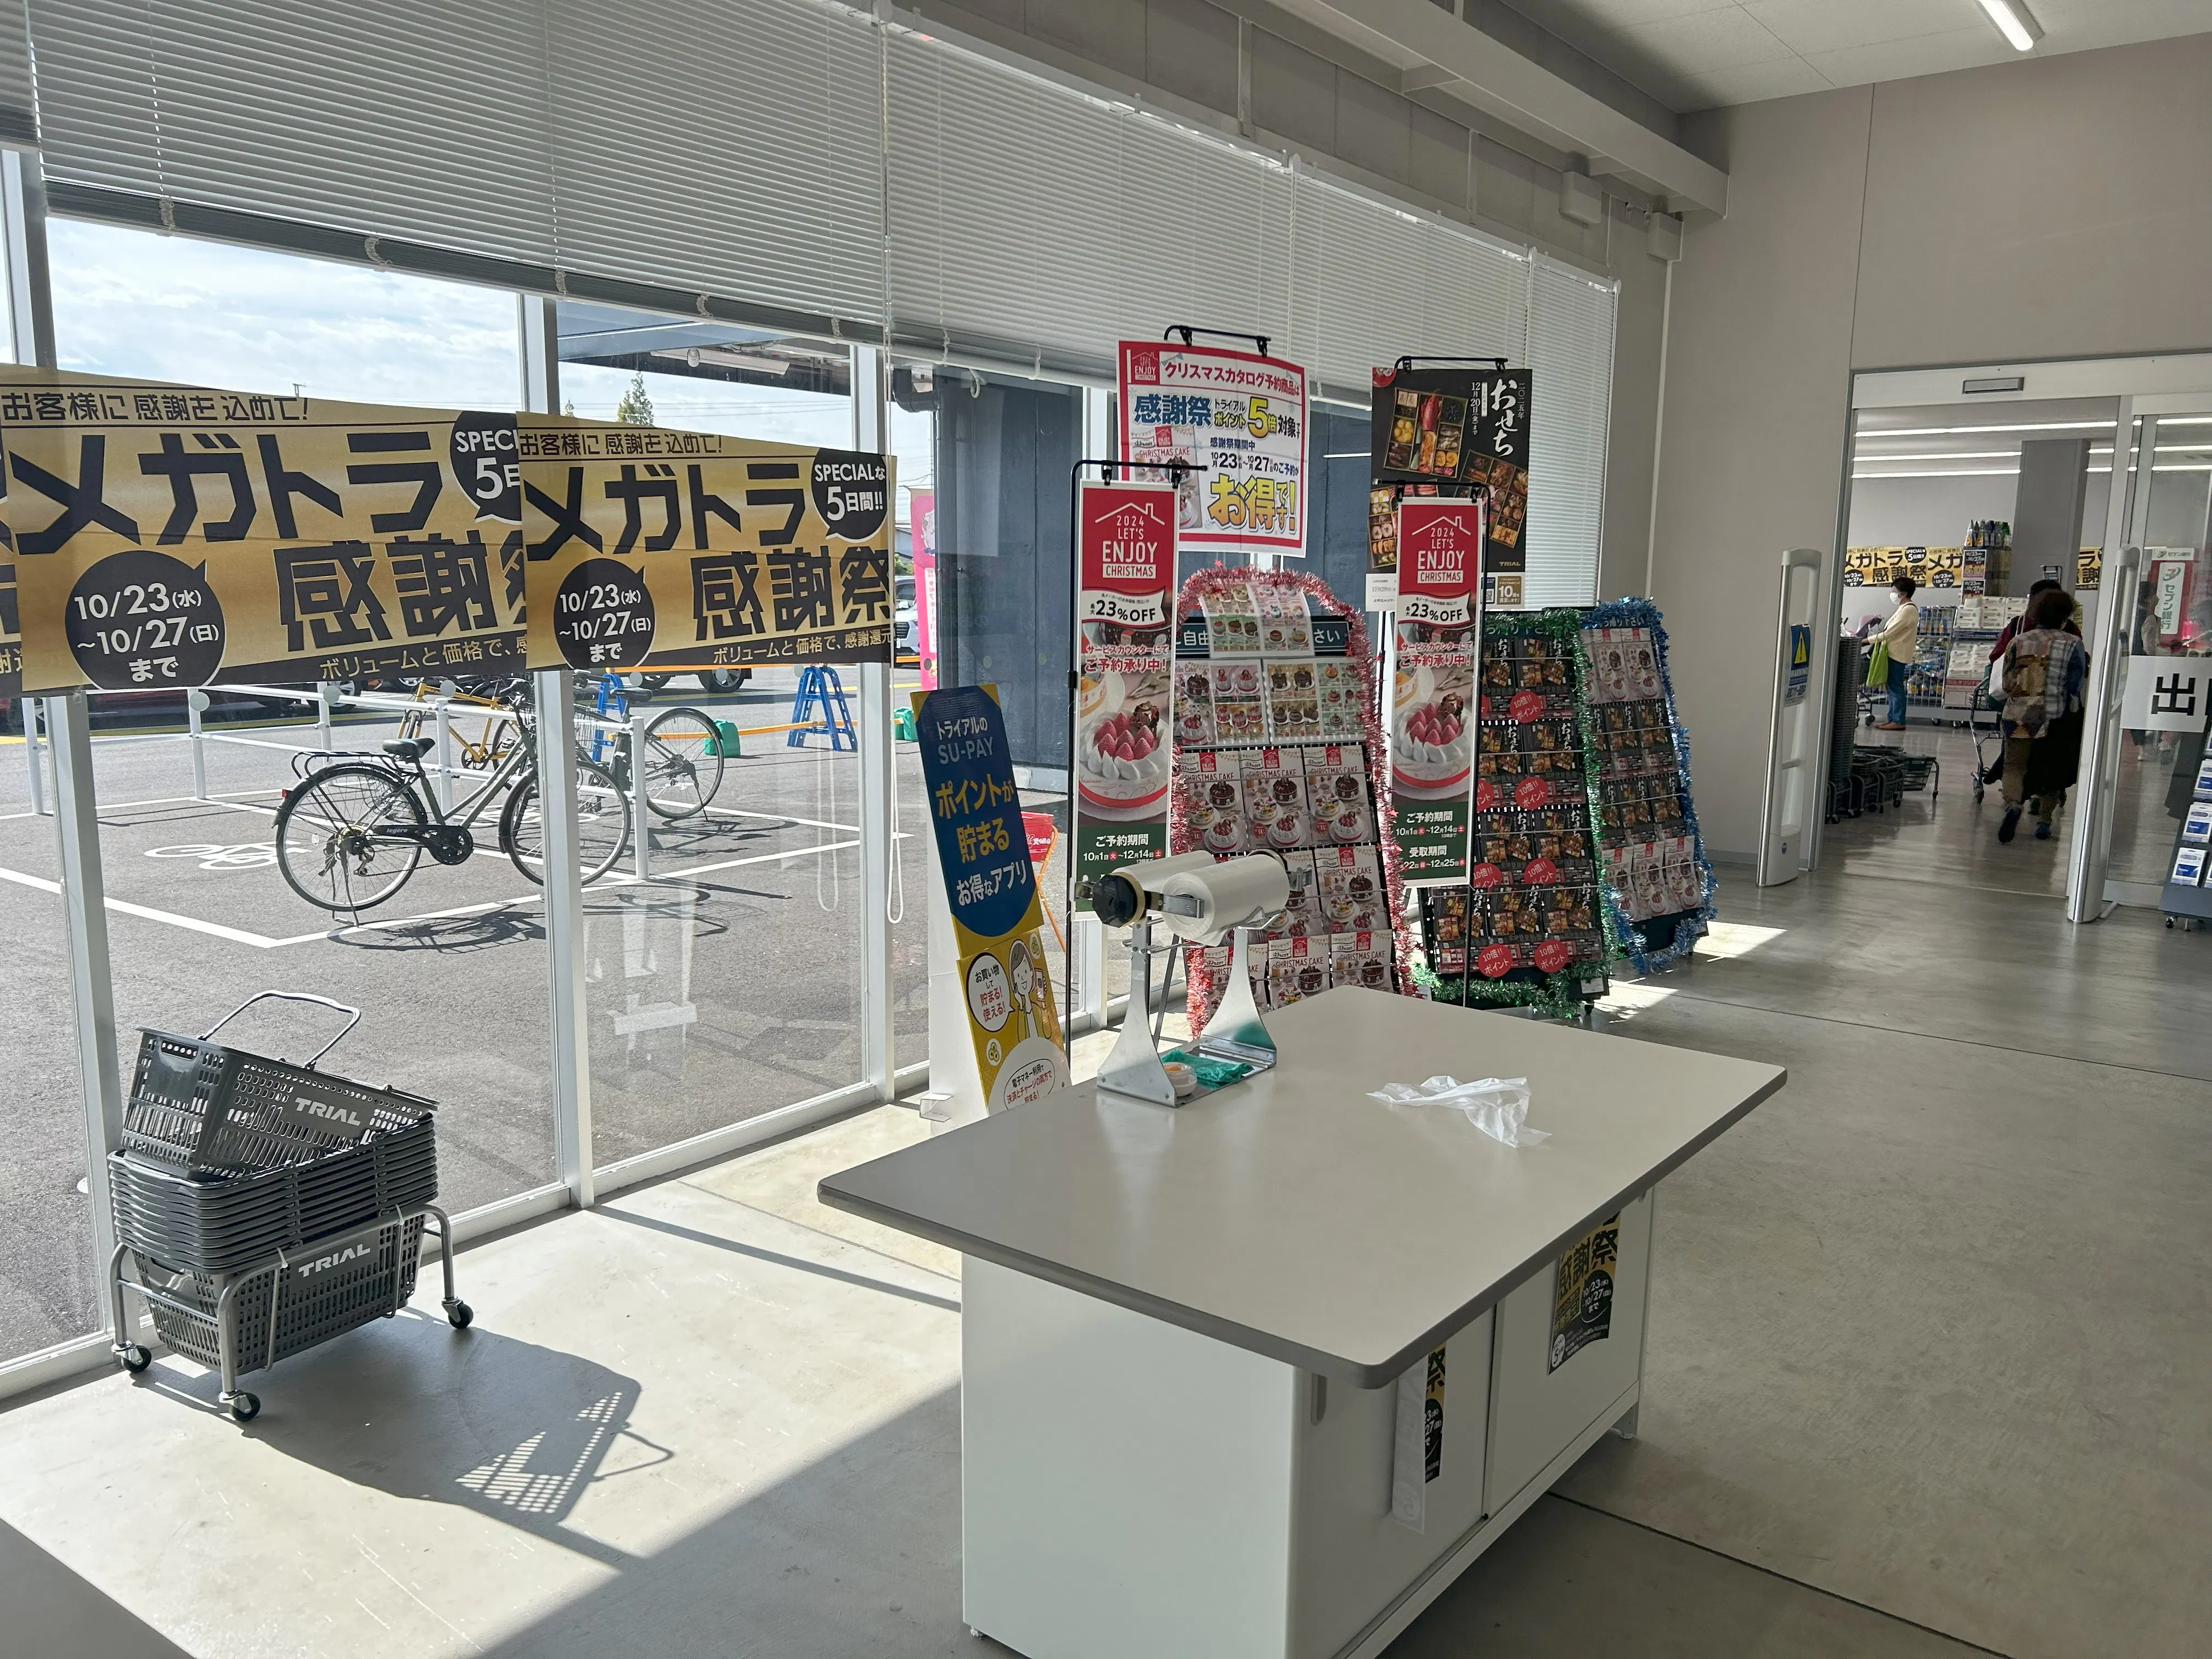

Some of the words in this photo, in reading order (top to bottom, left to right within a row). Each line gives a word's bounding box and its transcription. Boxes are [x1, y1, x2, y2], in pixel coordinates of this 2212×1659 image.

[1135, 365, 1156, 375] ENJOY
[2, 392, 308, 422] お客様に感謝を込めて!
[1133, 393, 1212, 427] 感謝祭
[1215, 398, 1245, 412] トライアル
[1214, 412, 1246, 429] ポイント
[1491, 379, 1518, 457] おせち
[520, 433, 722, 456] お客様に感謝を込めて!
[1139, 449, 1173, 458] CHRISTMAS
[1175, 447, 1190, 455] CAKE
[1210, 437, 1255, 451] 感謝祭期間中
[814, 463, 886, 483] SPECIALな
[9, 432, 442, 554] メガトラ
[523, 464, 806, 562] メガトラ
[827, 486, 884, 521] 5日間!!
[1116, 516, 1144, 527] 2024
[1118, 528, 1144, 540] LET'S
[1431, 528, 1454, 538] 2024
[1103, 540, 1158, 563] ENJOY
[1431, 538, 1454, 549] LET'S
[1418, 550, 1465, 570] ENJOY
[1928, 553, 1962, 570] メガ
[1106, 565, 1153, 577] CHRISTMAS
[1420, 572, 1461, 582] CHRISTMAS
[74, 583, 201, 620] 10/23(水)
[560, 584, 641, 614] 10/23(水)
[690, 545, 893, 641] 感謝祭
[1096, 600, 1155, 622] 23%OFF
[1410, 603, 1463, 621] 23%OFF
[589, 643, 622, 663] まで
[1087, 645, 1169, 654] サービスカウンターにて
[1401, 642, 1472, 651] サービスカウンターにて
[128, 654, 178, 682] まで
[1085, 658, 1166, 673] ご予約承り中!
[1400, 654, 1471, 668] ご予約承り中!
[2151, 673, 2212, 716] 出
[936, 716, 988, 741] トライアルの
[938, 736, 994, 765] SU-PAY
[1184, 774, 1217, 782] CHRISTMAS
[1249, 770, 1280, 778] CHRISTMAS
[935, 773, 1015, 820] ポイントが
[1407, 811, 1453, 823] ご予約期間
[957, 817, 1010, 864] 貯まる
[1096, 833, 1149, 847] ご予約期間
[1409, 845, 1447, 857] 受取期間
[1327, 868, 1356, 877] CHRISTMAS
[956, 860, 1027, 906] お得なアプリ
[1276, 958, 1307, 968] CHRISTMAS
[1309, 957, 1323, 965] CAKE
[1340, 952, 1370, 962] CHRISTMAS
[1372, 950, 1385, 958] CAKE
[975, 964, 1000, 984] お買い物
[986, 979, 994, 988] して
[980, 986, 1003, 1006] 貯まる!
[983, 1001, 1006, 1022] 使える!
[295, 1097, 361, 1126] TRIAL
[299, 1243, 371, 1277] TRIAL
